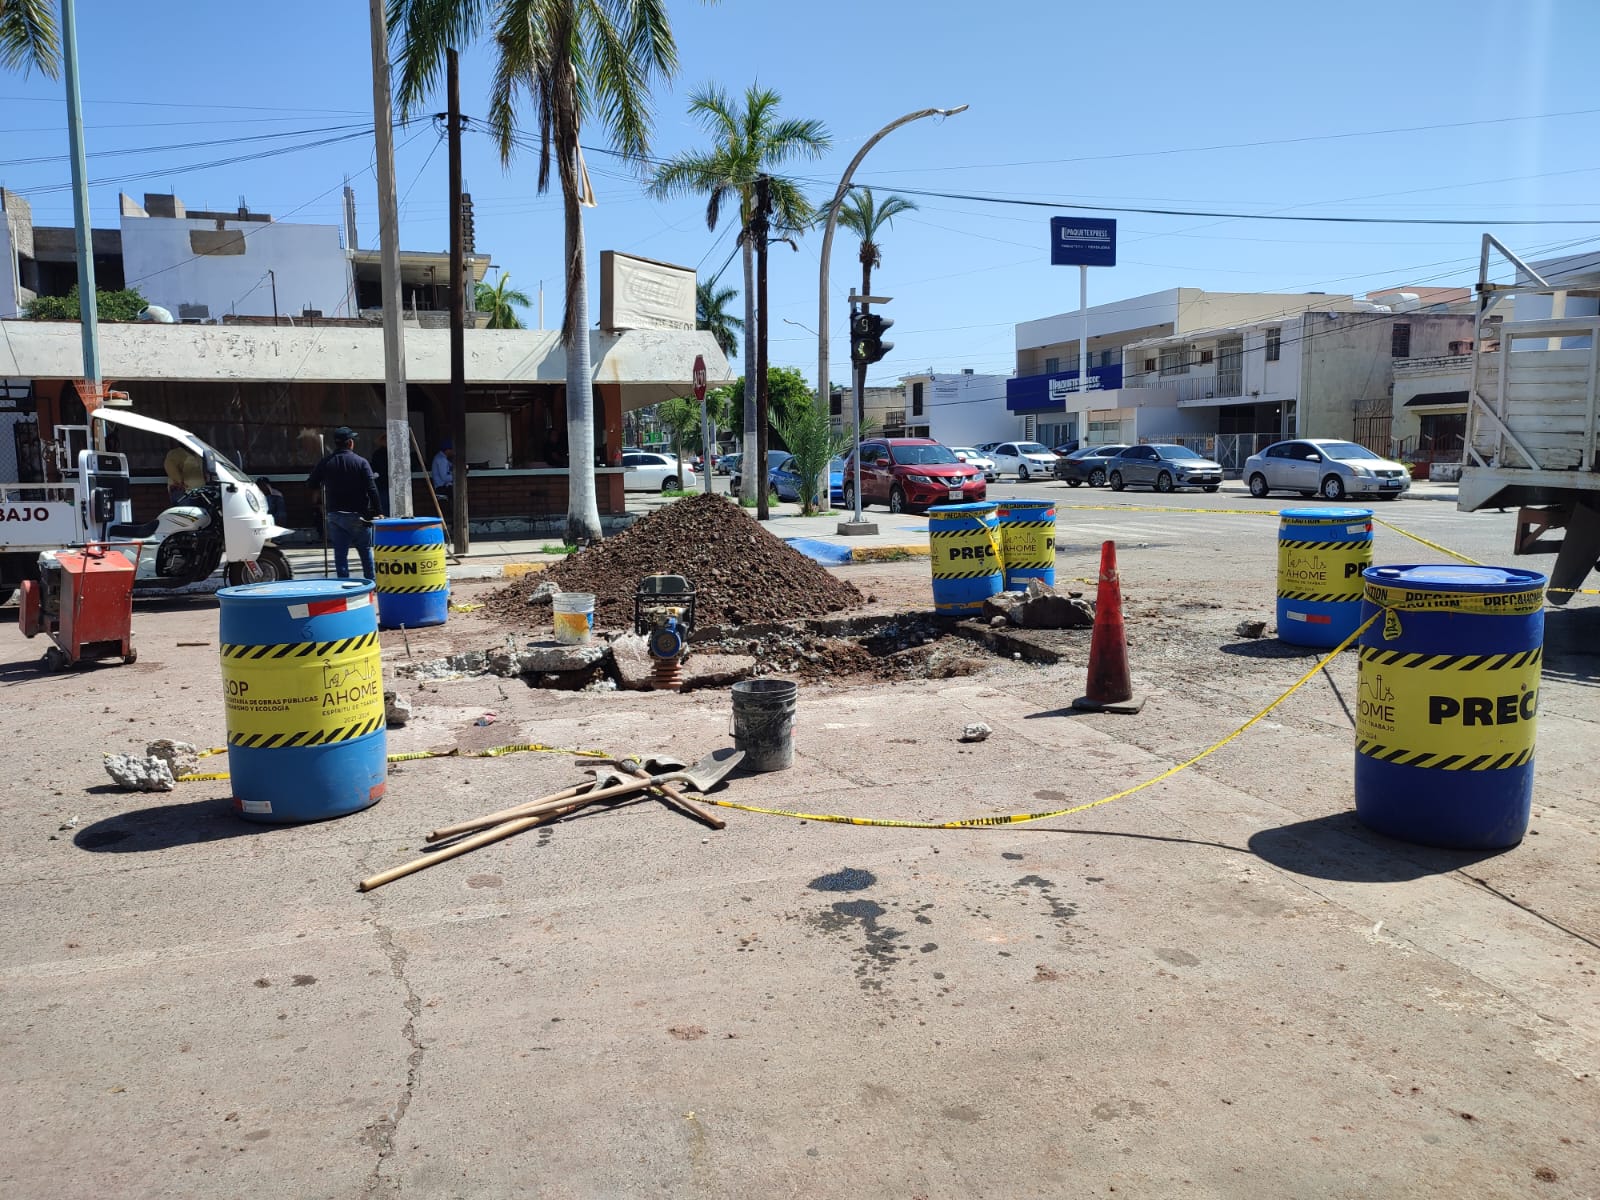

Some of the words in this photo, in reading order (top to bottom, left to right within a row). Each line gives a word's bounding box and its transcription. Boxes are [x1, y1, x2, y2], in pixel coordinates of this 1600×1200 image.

[949, 545, 998, 561] PREC
[1286, 569, 1328, 581] AHOME
[322, 680, 378, 707] AHOME
[1429, 690, 1539, 726] PREC
